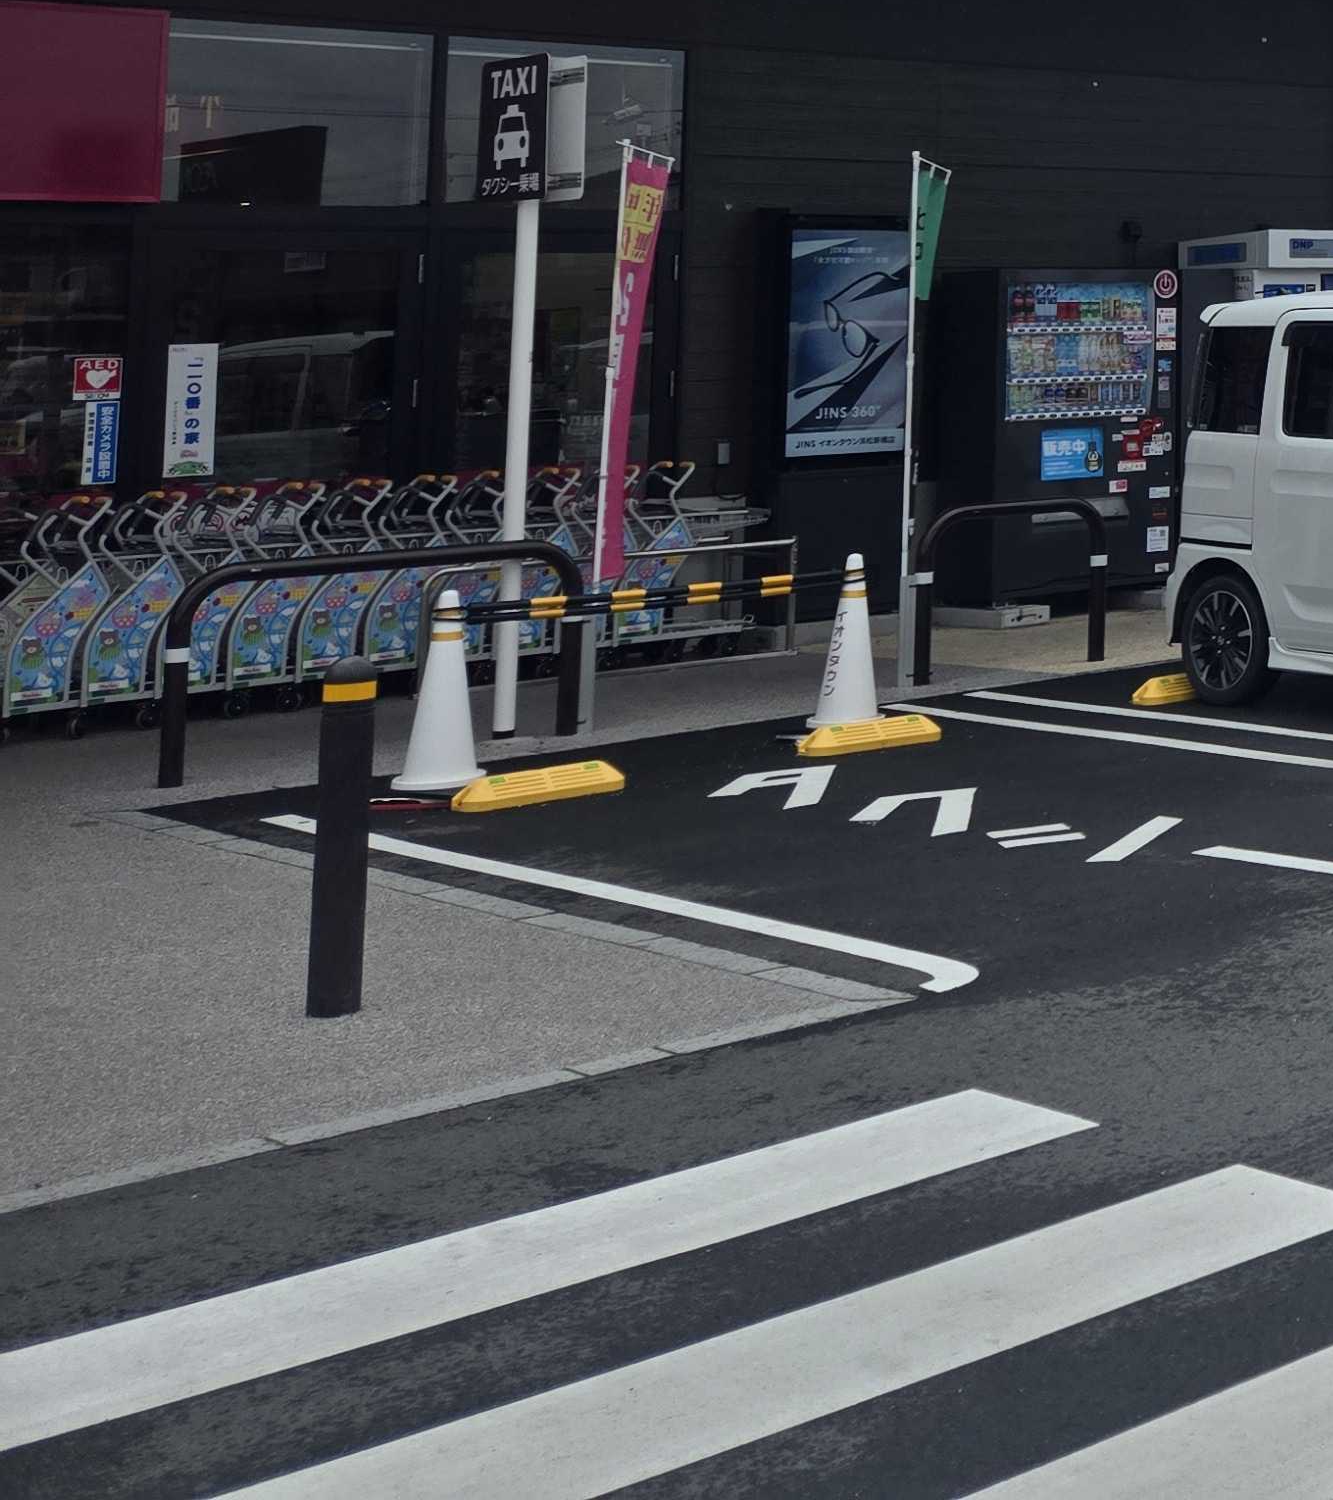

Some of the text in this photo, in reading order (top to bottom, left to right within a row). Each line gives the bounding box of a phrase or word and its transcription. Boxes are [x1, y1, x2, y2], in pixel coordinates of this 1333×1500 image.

[490, 65, 538, 100] TAXI
[480, 172, 541, 197] タクシー乗場
[1291, 240, 1314, 250] DNP
[79, 360, 119, 370] AED
[1043, 440, 1087, 456] 販売中
[823, 610, 849, 698] イオンタウン
